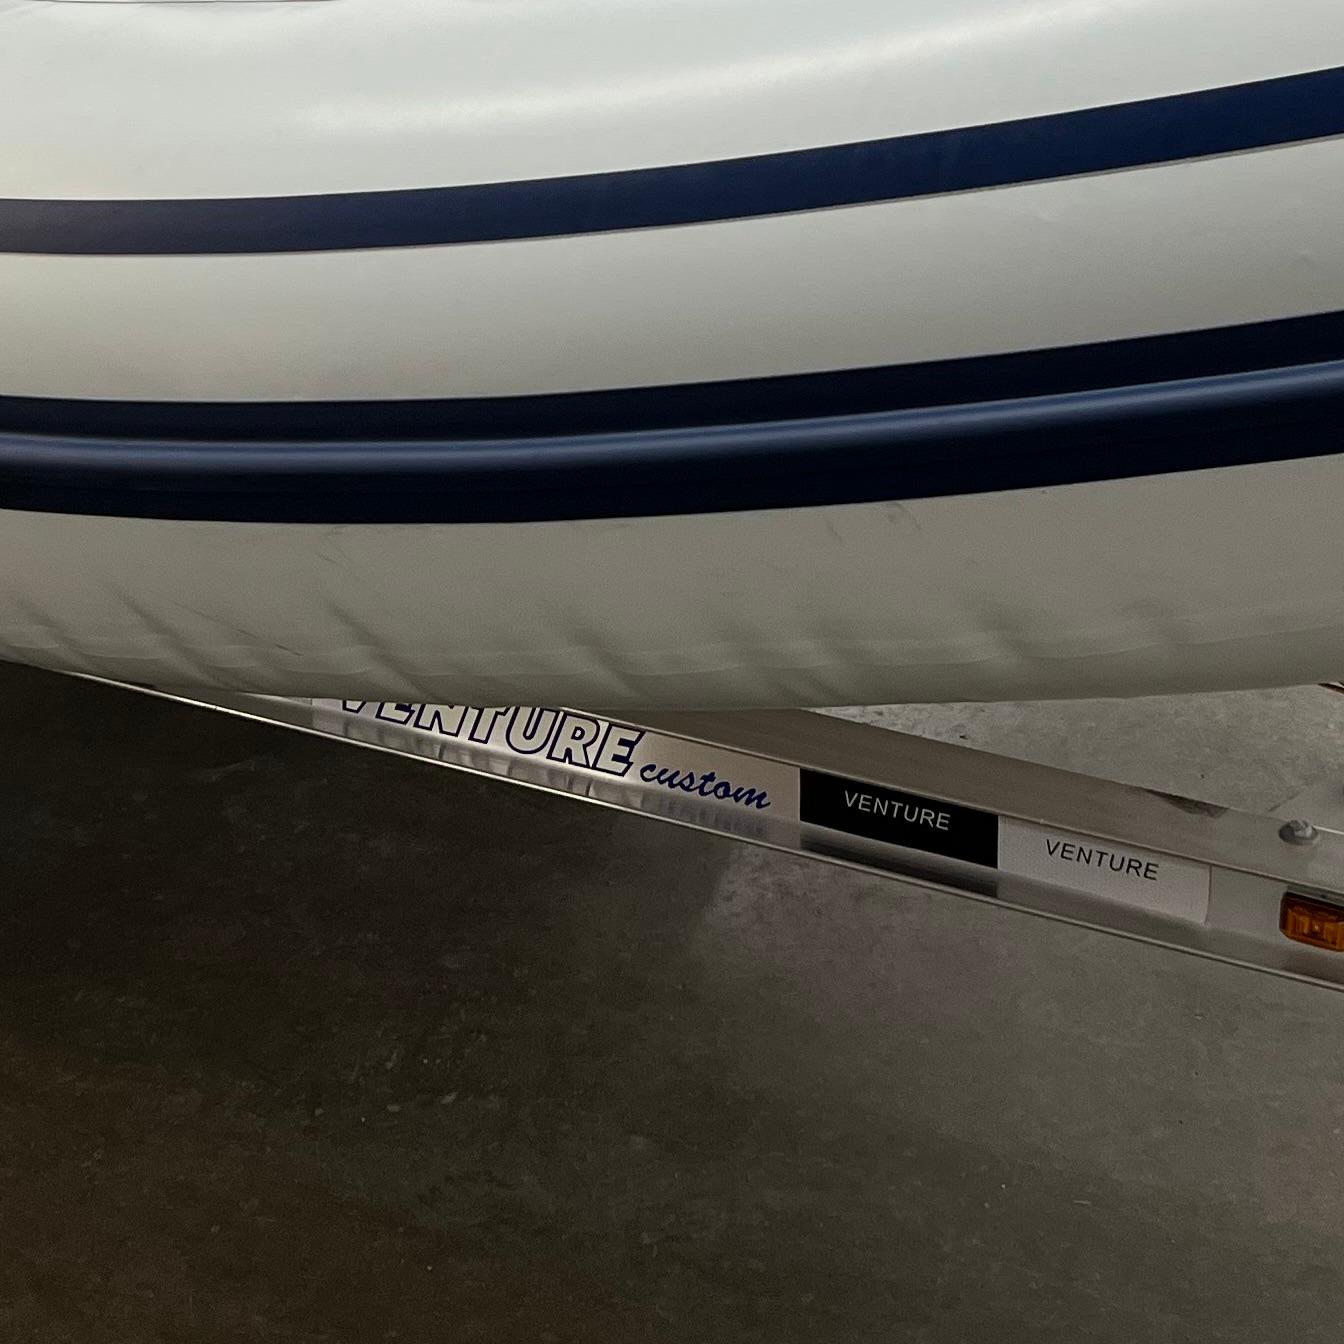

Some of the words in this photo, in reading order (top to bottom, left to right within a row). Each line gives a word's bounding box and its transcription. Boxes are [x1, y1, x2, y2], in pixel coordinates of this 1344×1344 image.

[639, 762, 772, 809] custom
[842, 789, 953, 832] VENTURE
[1044, 838, 1161, 882] VENTURE
